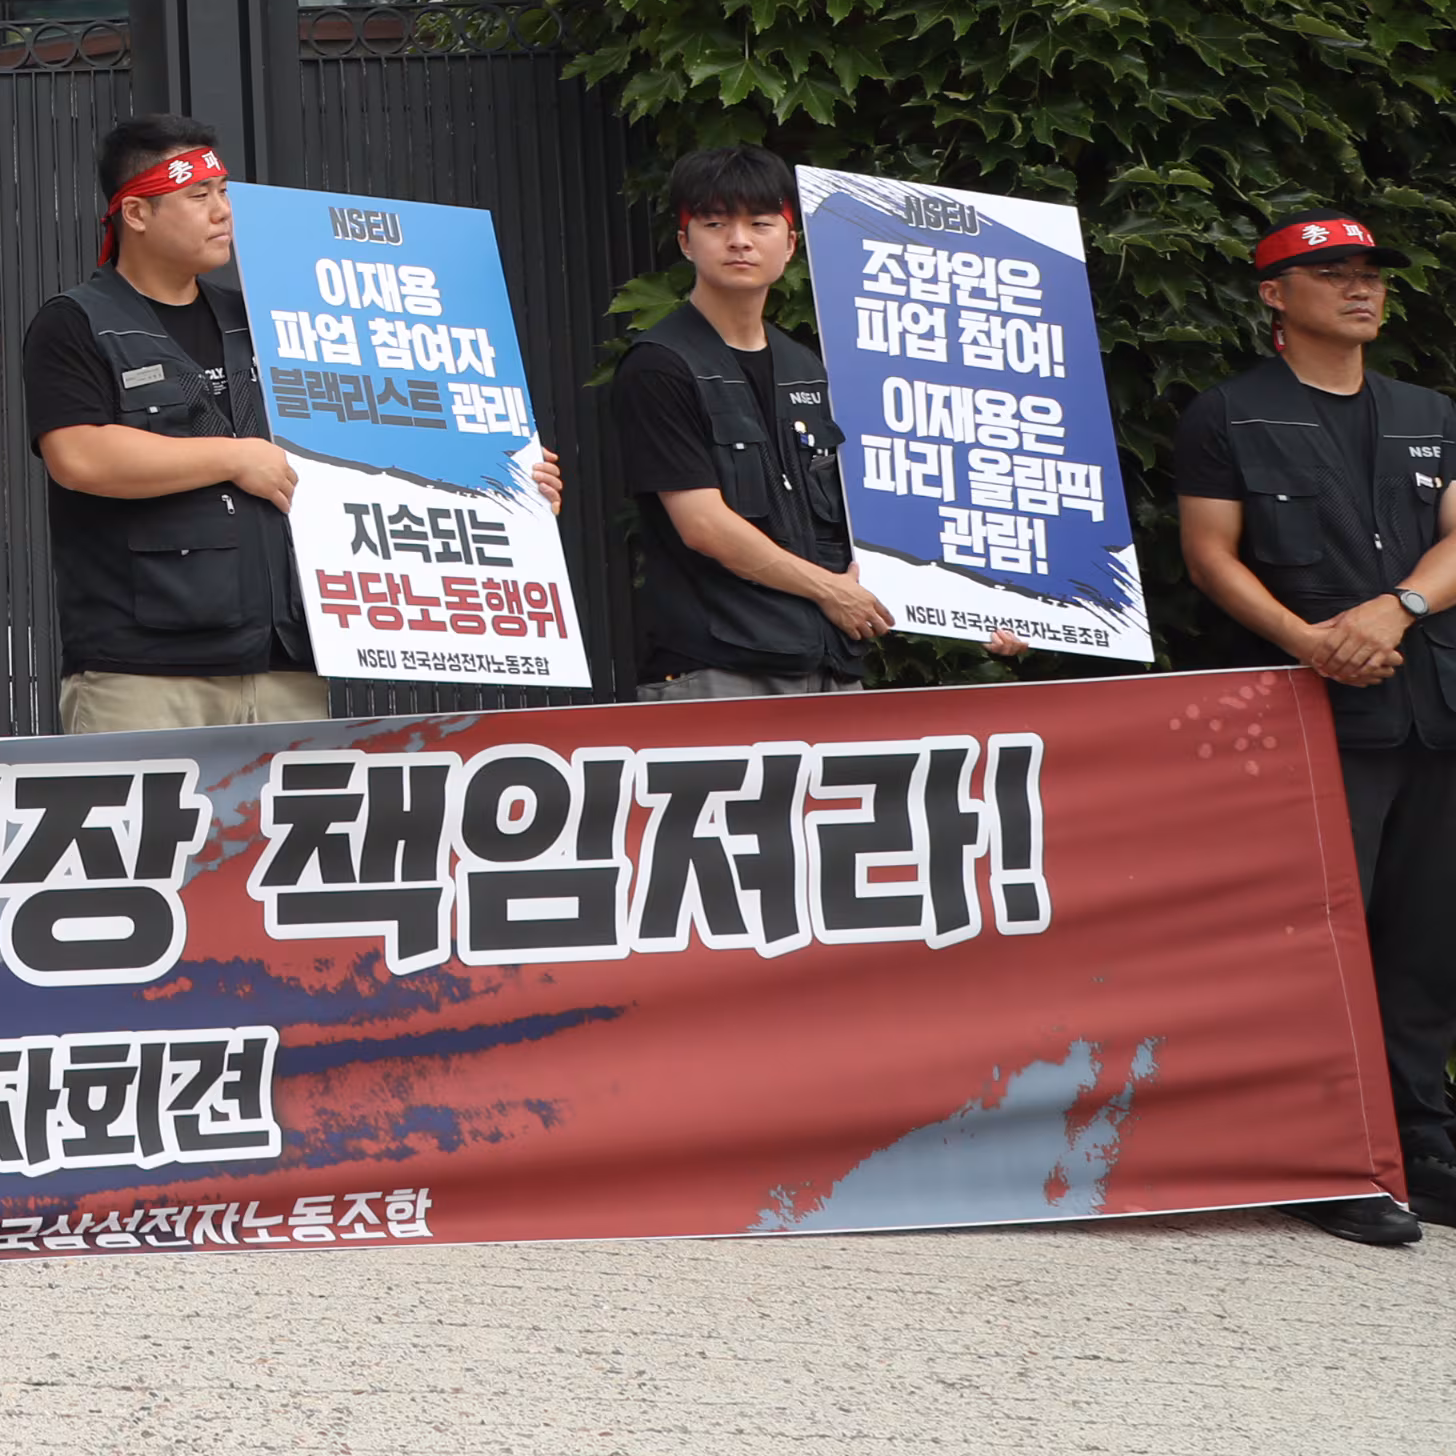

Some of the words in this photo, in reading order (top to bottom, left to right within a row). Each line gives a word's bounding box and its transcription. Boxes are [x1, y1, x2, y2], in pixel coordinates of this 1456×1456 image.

[328, 206, 403, 246] NSEU
[902, 197, 981, 236] NSEU
[315, 258, 443, 317] 이재용
[861, 239, 1043, 317] 조합원은
[270, 310, 362, 367] 파업
[371, 317, 495, 378] 참여자
[854, 297, 947, 363] 파업
[957, 311, 1066, 379] 참여!
[269, 367, 447, 430] 블랙리스트
[447, 382, 531, 437] 관리!
[789, 391, 822, 405] NSEU
[882, 376, 1065, 455] 이재용은
[860, 433, 956, 503] 파리
[967, 447, 1105, 523] 올림픽
[1409, 446, 1442, 459] NSE
[343, 502, 514, 567] 지속되는
[938, 505, 1049, 575] 관람!
[315, 569, 568, 639] 부당노동행위
[906, 604, 946, 627] NSEU
[357, 648, 397, 669] NSEU
[401, 650, 551, 676] 전국삼성전자노동조합
[248, 732, 1051, 977] 책임져라!
